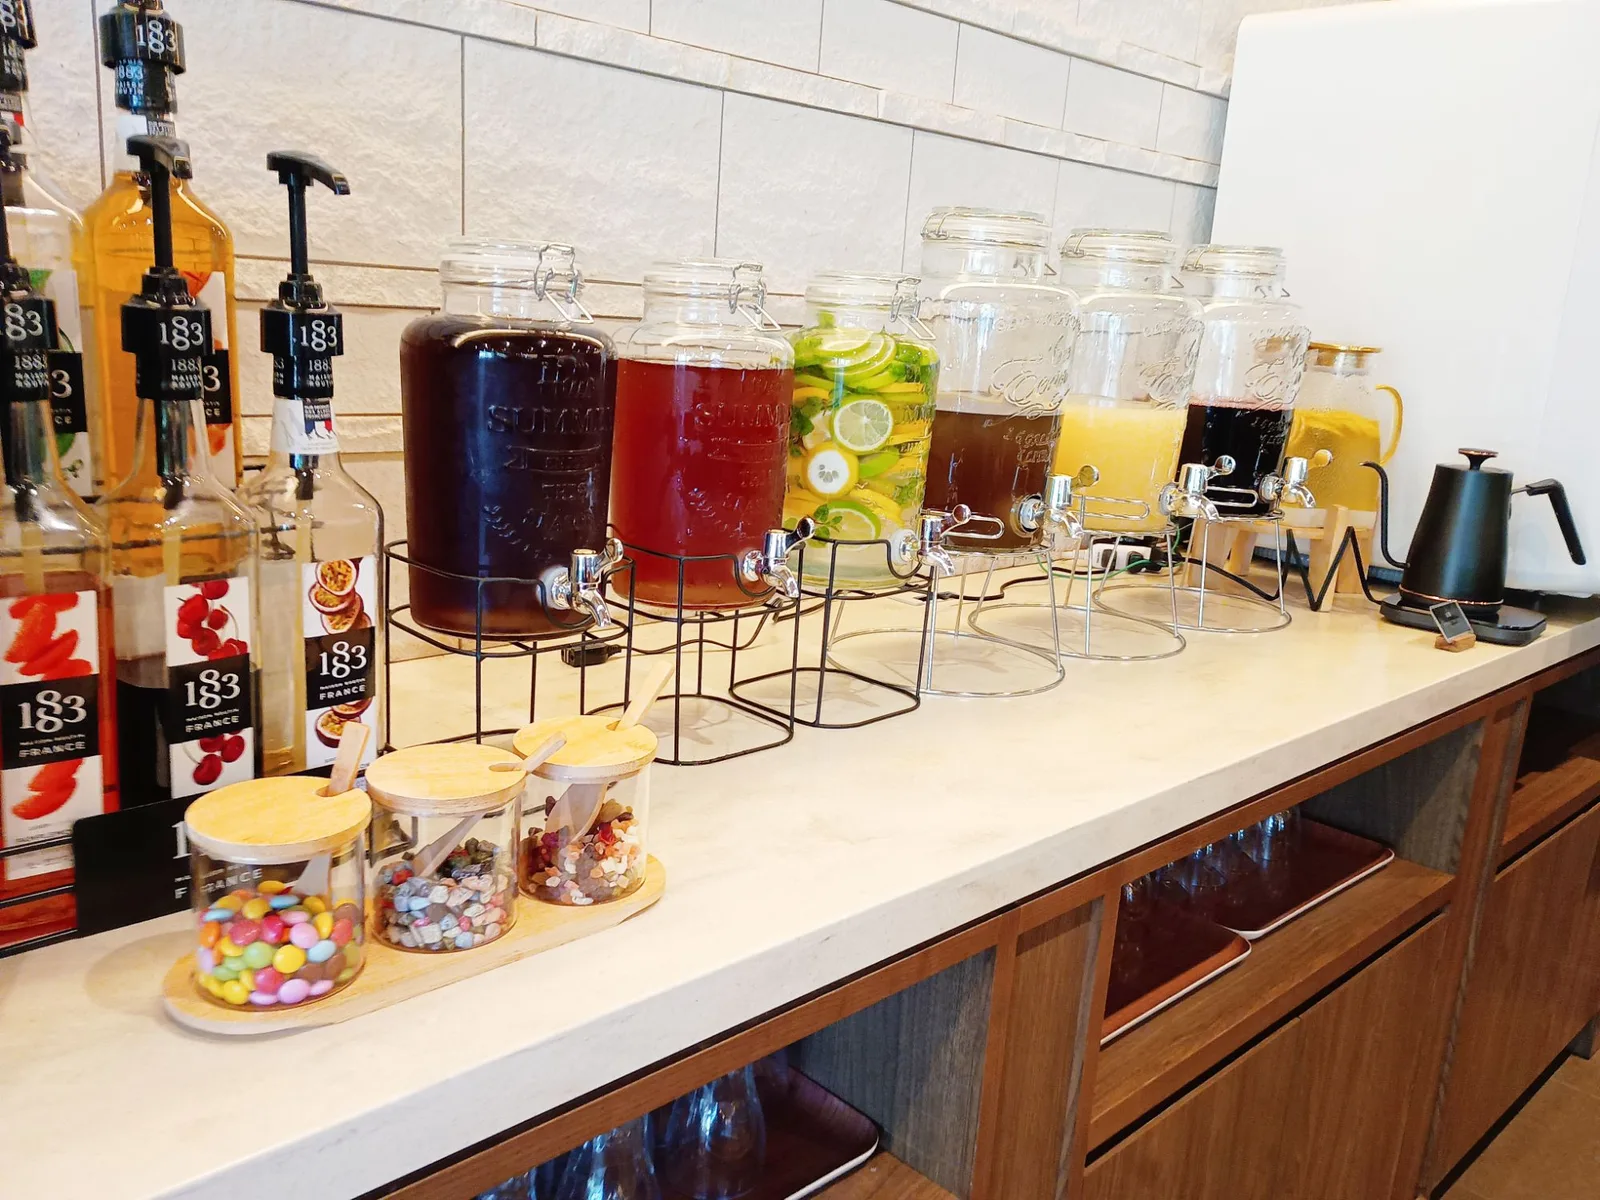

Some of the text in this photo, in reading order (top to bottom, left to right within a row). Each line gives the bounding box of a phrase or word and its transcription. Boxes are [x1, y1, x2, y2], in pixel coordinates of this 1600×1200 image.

[0, 303, 43, 341] 883
[319, 684, 366, 701] FRANCE
[185, 715, 240, 733] FRANCE
[19, 741, 86, 758] FRANCE
